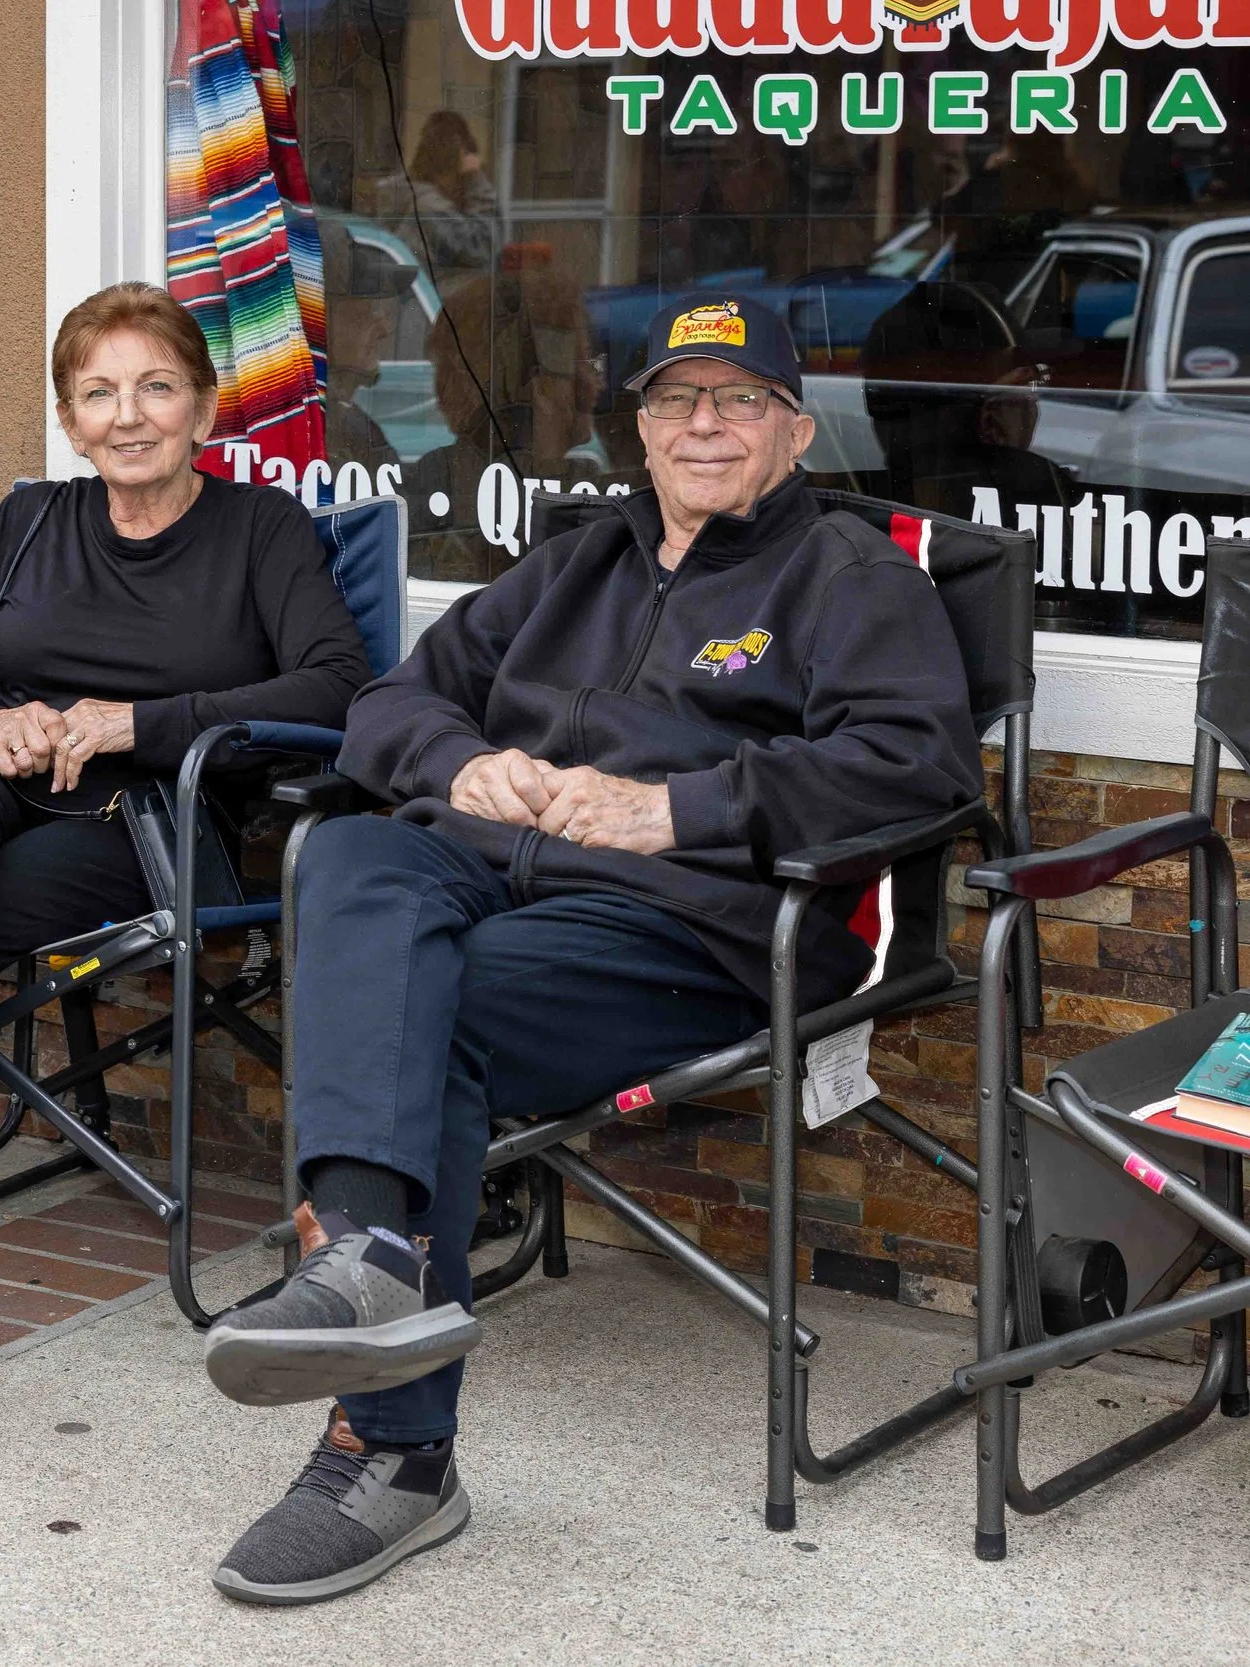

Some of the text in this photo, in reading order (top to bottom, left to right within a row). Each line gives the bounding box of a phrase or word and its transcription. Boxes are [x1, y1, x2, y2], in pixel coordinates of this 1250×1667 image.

[607, 69, 1227, 146] TAQUERIA
[671, 314, 742, 343] Spanky's
[971, 486, 1250, 598] uthe
